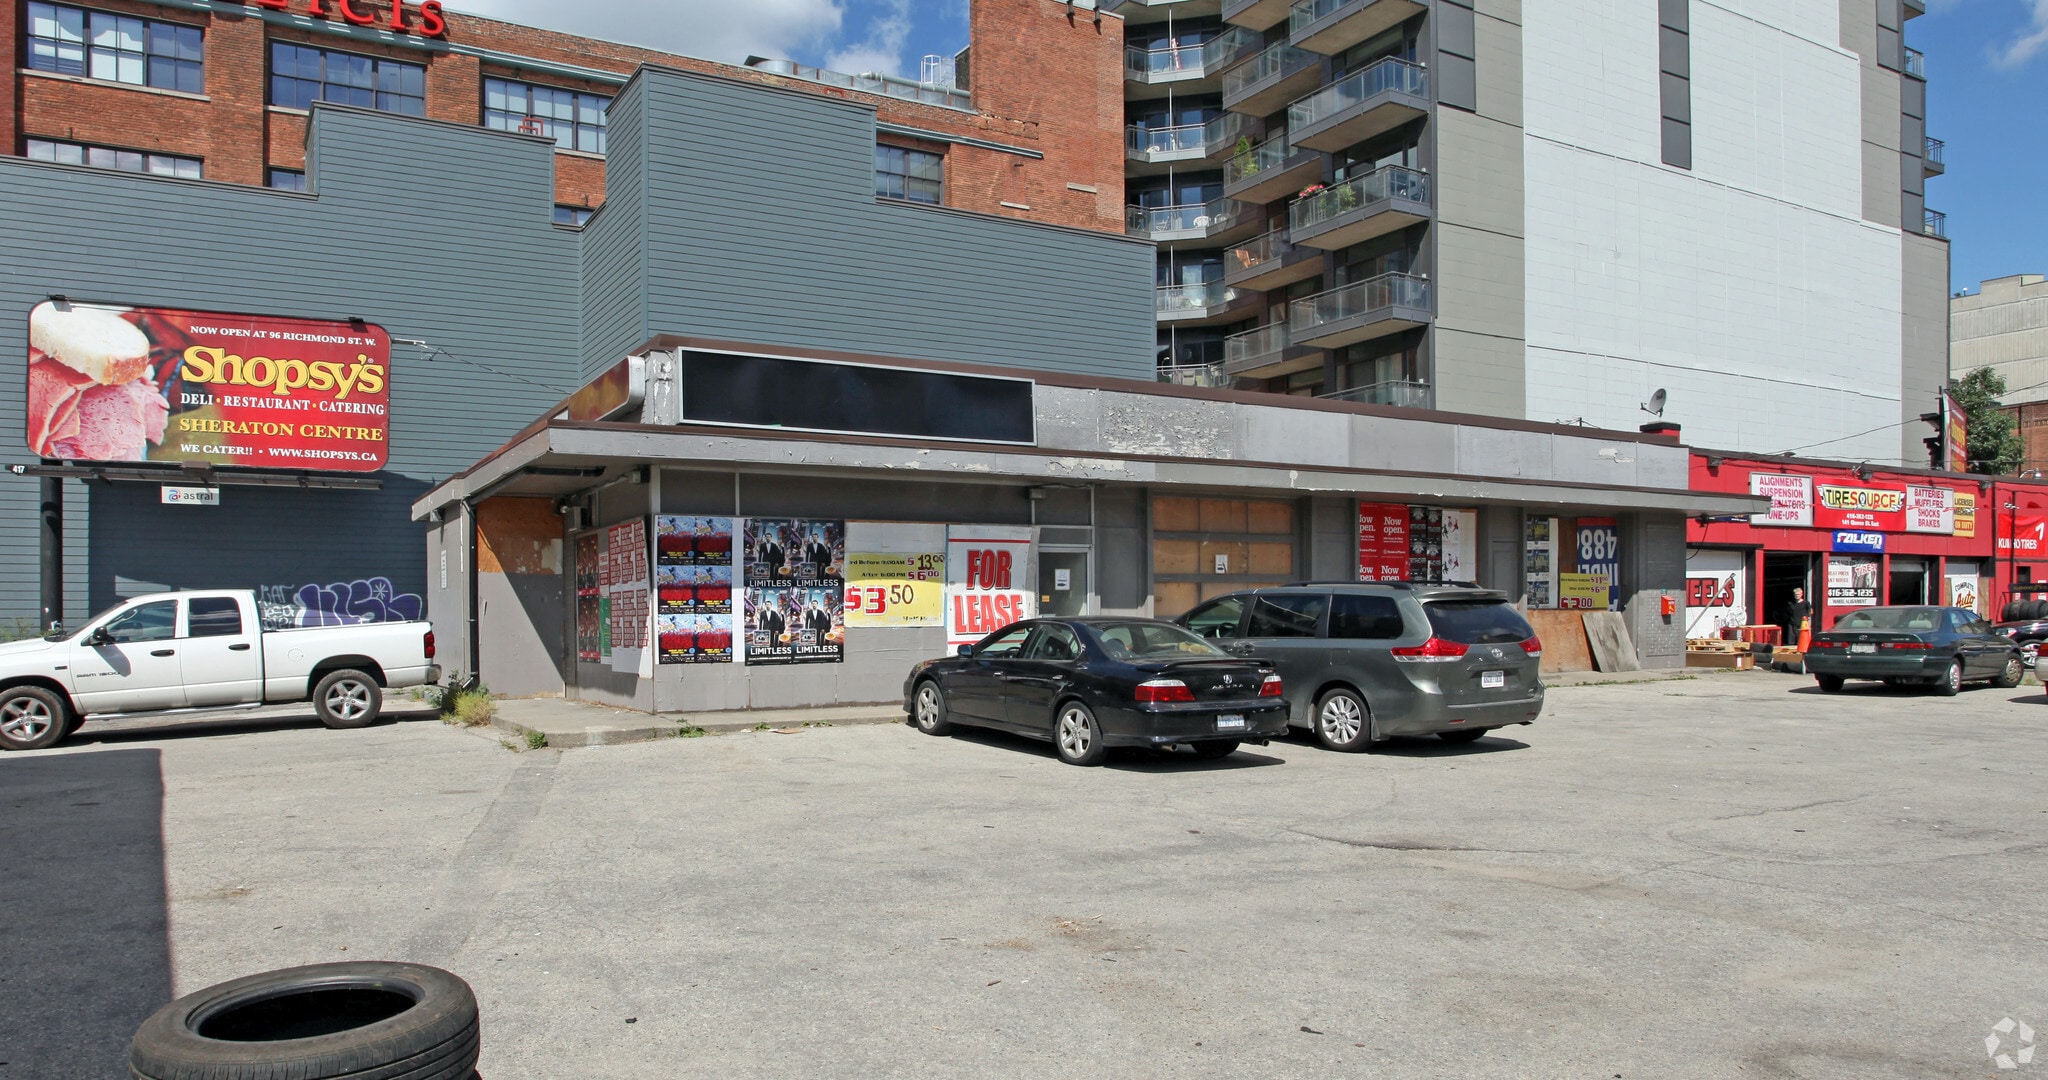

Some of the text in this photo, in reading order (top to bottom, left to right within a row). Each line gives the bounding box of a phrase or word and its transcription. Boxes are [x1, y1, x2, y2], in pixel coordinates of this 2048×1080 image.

[190, 326, 376, 346] NOW OPEN AT 96 RICHMOND ST. W.
[181, 345, 385, 400] Shopsy's
[180, 392, 385, 415] DELI RESTAURANT CATERING
[179, 418, 384, 441] SHERATON CENTRE
[180, 444, 378, 461] WE CATER!! WWW.SHOPSYS.CA
[12, 465, 25, 474] 417
[1759, 476, 1803, 487] ALIGNMENTS
[183, 491, 214, 501] astral
[1759, 487, 1804, 498] SUSPENSION
[1914, 488, 1945, 499] BATTERIES
[1914, 498, 1944, 509] MUFFLERS
[1917, 508, 1940, 518] SHOCKS
[1384, 516, 1402, 525] Now
[1918, 518, 1940, 528] BRAKES
[1360, 524, 1375, 533] pen.
[1383, 526, 1405, 535] open.
[1837, 532, 1882, 546] FALKEN
[2020, 539, 2037, 549] TIRES
[966, 549, 1012, 591] FOR
[1381, 565, 1399, 574] Now
[750, 579, 791, 587] LIMITLESS
[796, 579, 839, 587] LIMITLESS
[1686, 578, 1735, 607] EELS
[1956, 590, 1975, 607] Auto
[953, 594, 1025, 636] LEASE
[750, 647, 791, 655] LIMITLESS
[796, 645, 838, 654] LIMITLESS
